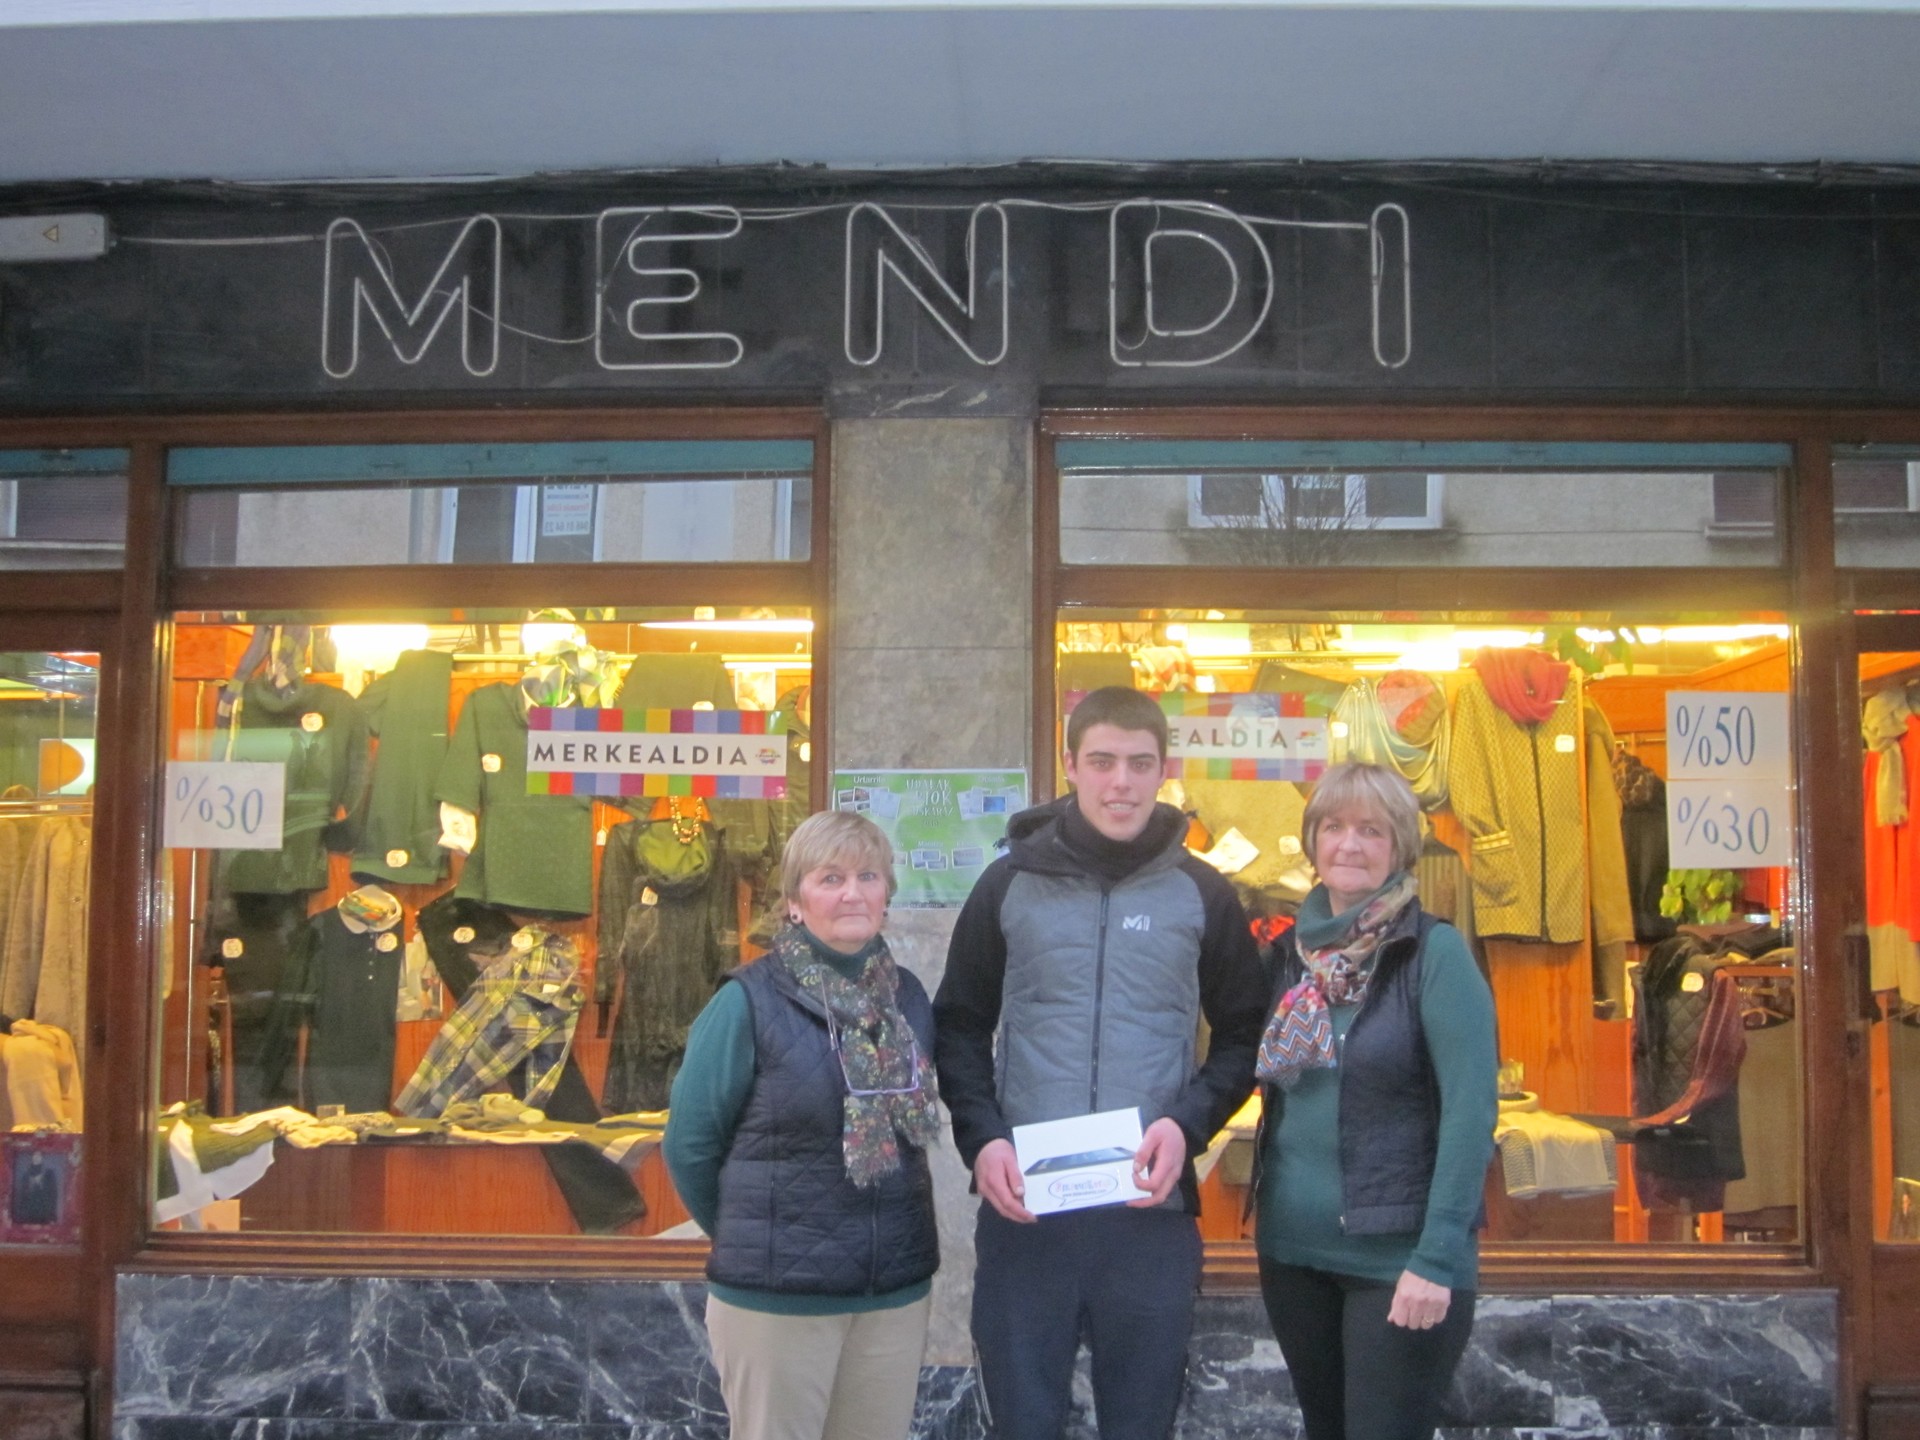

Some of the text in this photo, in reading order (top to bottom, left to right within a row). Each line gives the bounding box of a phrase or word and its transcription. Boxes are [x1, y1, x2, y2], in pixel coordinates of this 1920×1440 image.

[322, 200, 1411, 378] MENDI
[533, 743, 747, 765] MERKEALDIA
[1167, 728, 1288, 748] EALDIA
[1676, 705, 1755, 767] %50
[176, 776, 263, 834] %30
[1677, 796, 1769, 855] %30
